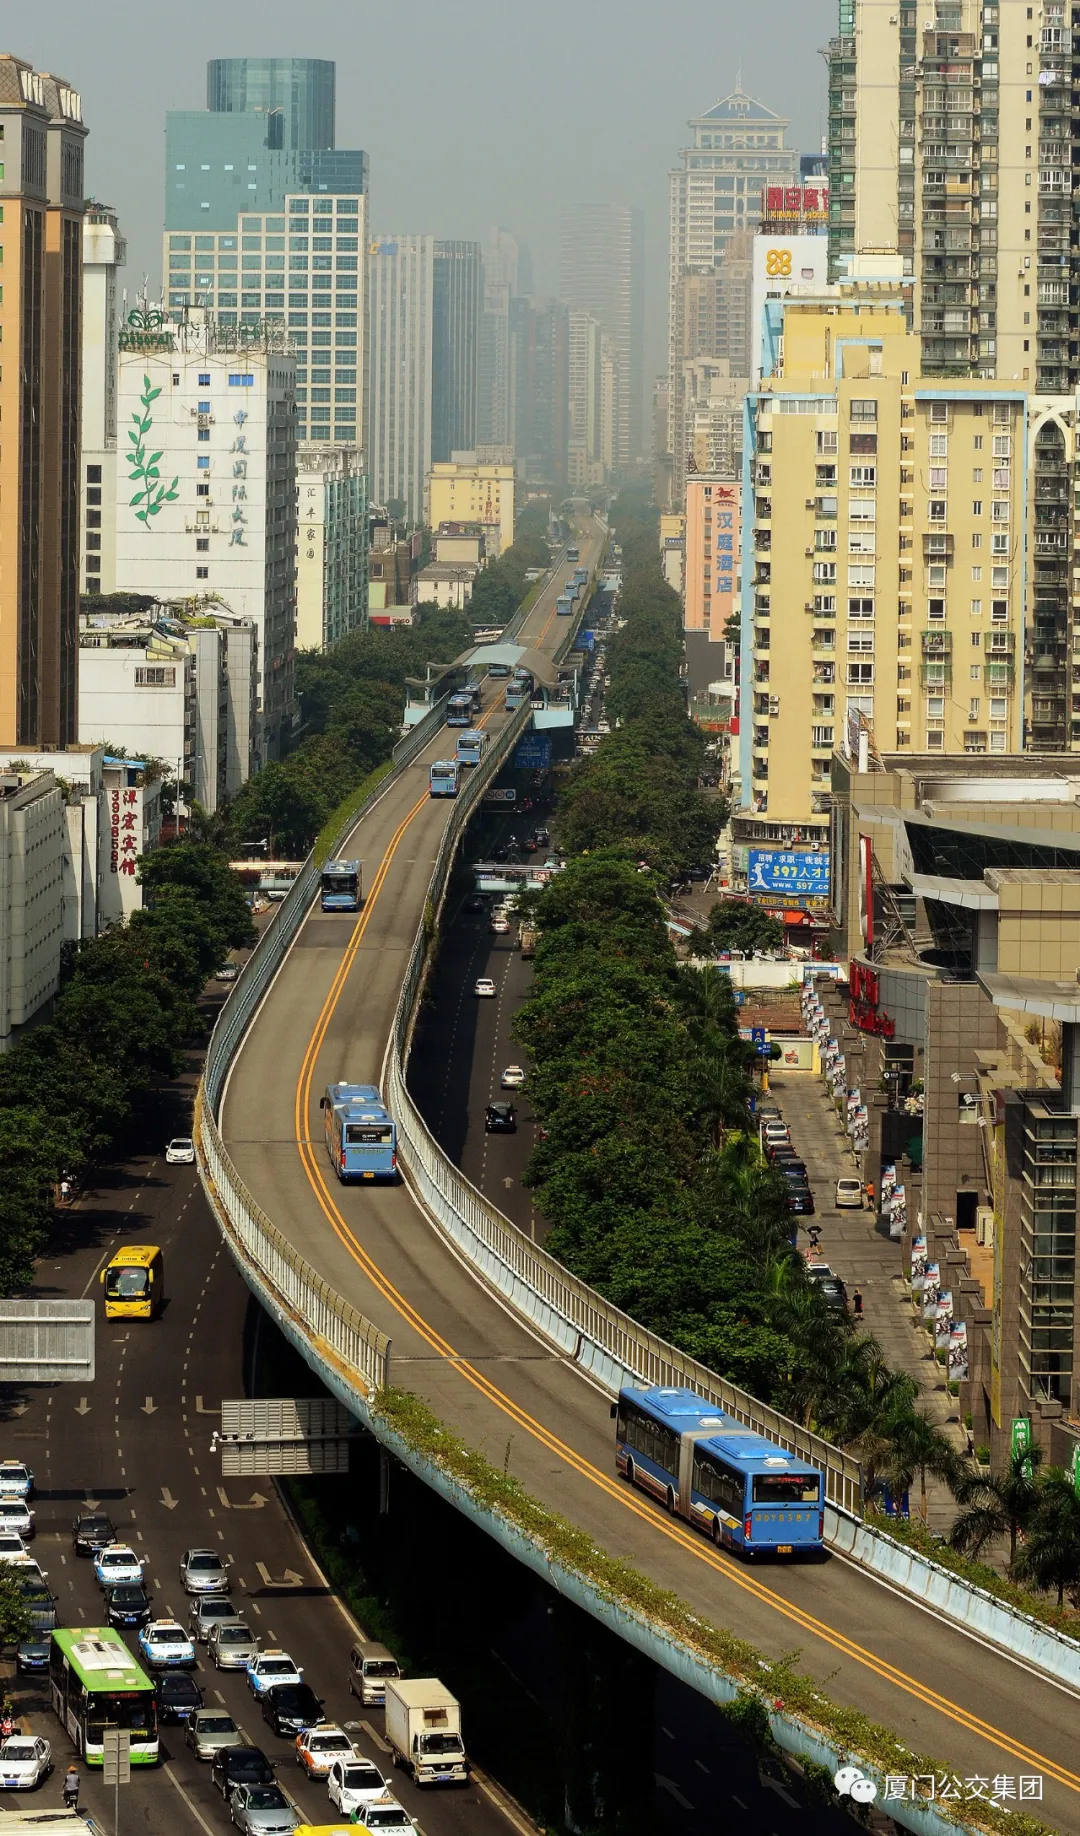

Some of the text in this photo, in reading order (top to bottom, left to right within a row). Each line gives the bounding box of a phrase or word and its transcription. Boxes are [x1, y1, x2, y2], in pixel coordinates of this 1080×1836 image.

[306, 487, 316, 559] 汇丰家园
[716, 512, 733, 593] 汉庭酒店
[110, 790, 120, 873] 3998585
[796, 881, 813, 890] 597
